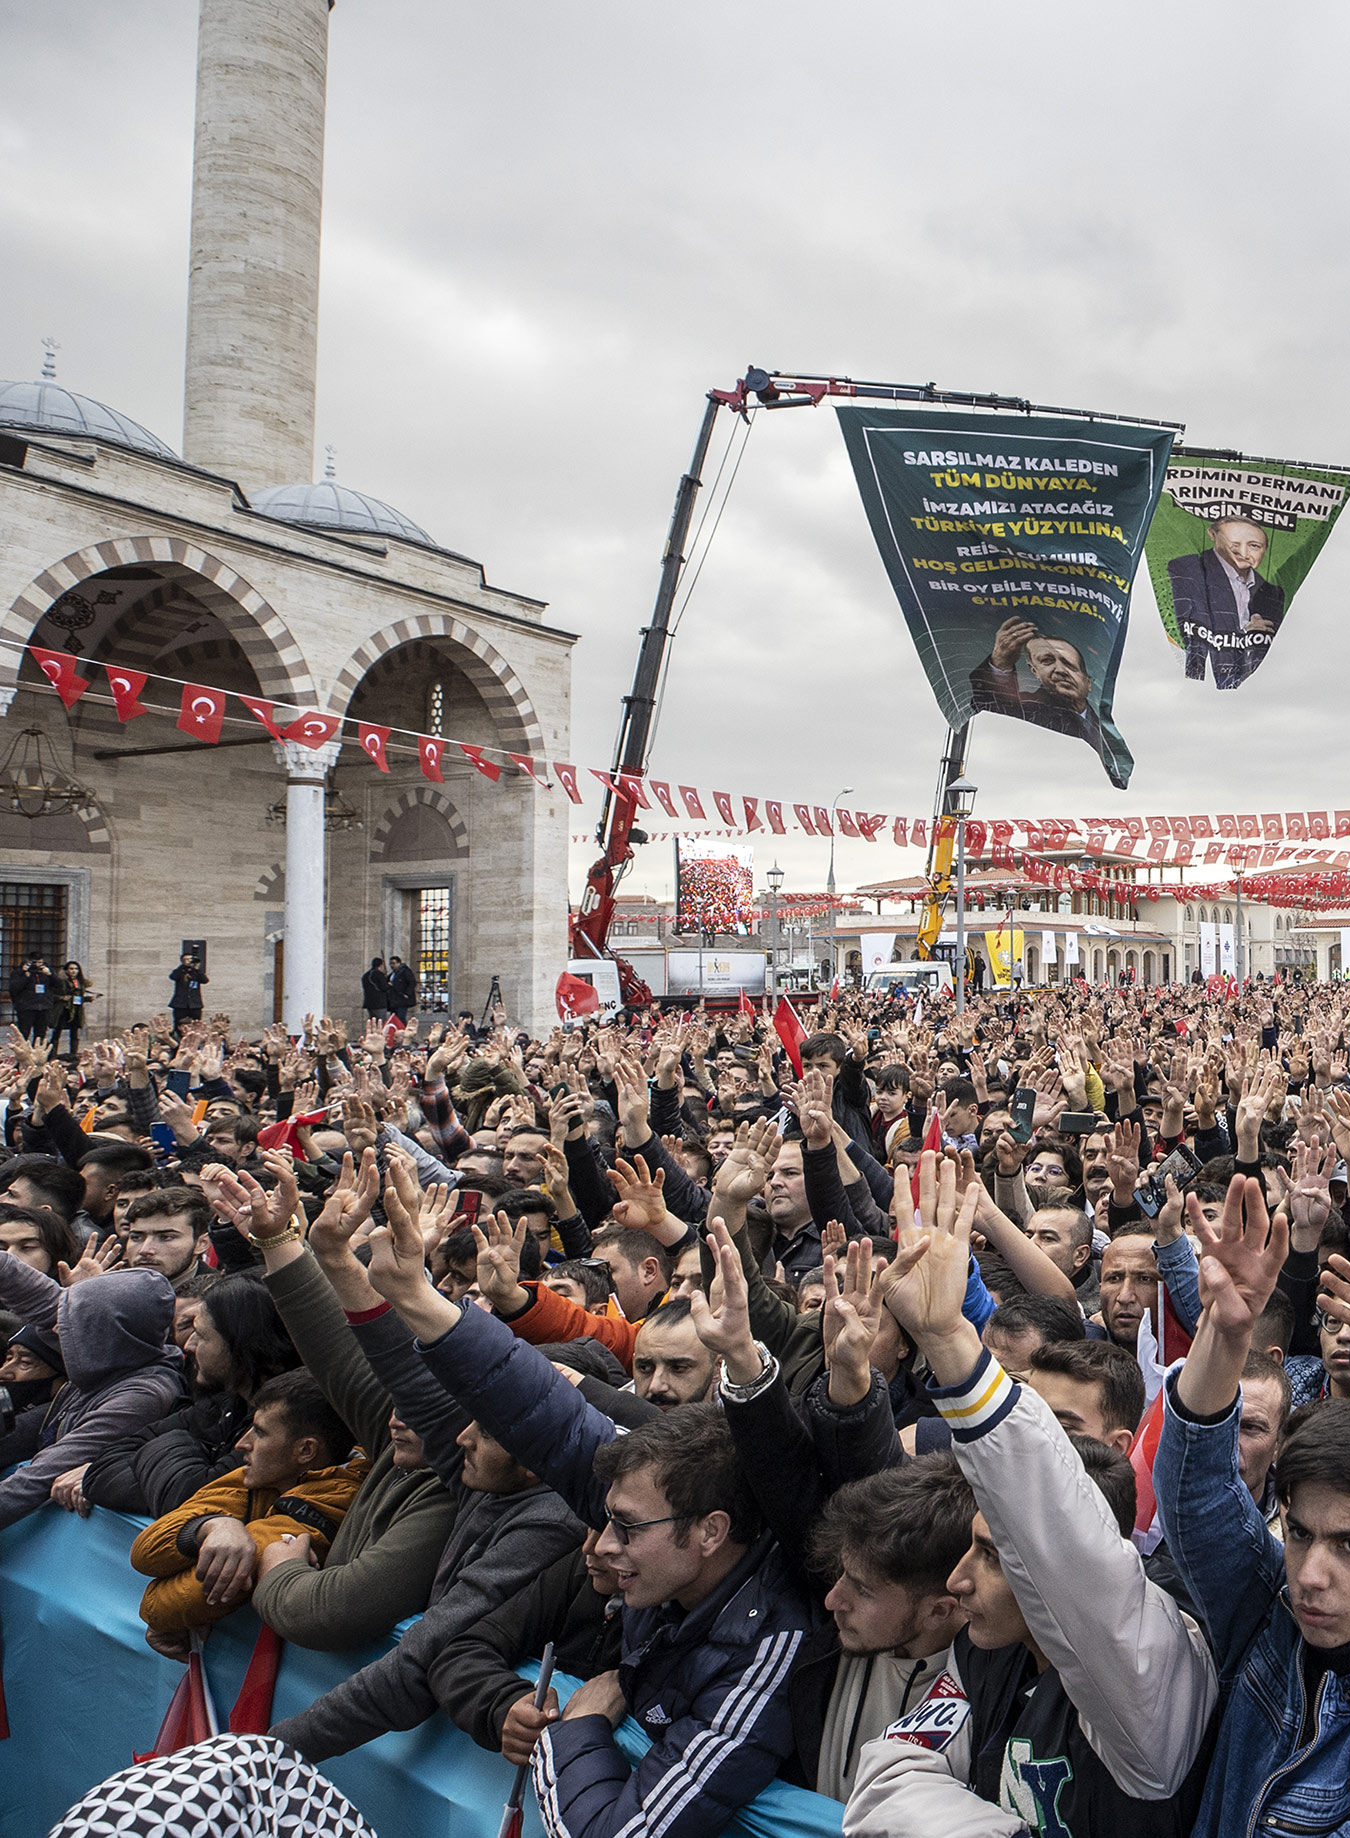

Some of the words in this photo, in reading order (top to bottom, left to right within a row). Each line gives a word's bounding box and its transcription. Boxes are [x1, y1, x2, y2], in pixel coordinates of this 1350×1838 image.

[903, 451, 1021, 470] SARSILMAZ
[1025, 457, 1118, 477] KALEDEN
[930, 469, 981, 488] TÜM
[985, 472, 1097, 493] DÜNYAYA,
[1166, 467, 1242, 483] RDİMİN
[1246, 475, 1342, 501] DERMANI
[922, 498, 1017, 516] İMZAMIZI
[1019, 501, 1114, 517] ATACAĞIZ
[1239, 491, 1329, 516] FERMANI
[911, 516, 1006, 538] TÜRKİYE
[1251, 510, 1295, 528] SEN.
[913, 557, 958, 575] HOŞ
[959, 557, 1037, 573] GELDİN
[928, 580, 962, 592] BİR
[963, 583, 989, 594] OY
[991, 580, 1033, 594] BİLE
[645, 1715, 672, 1724] adidas
